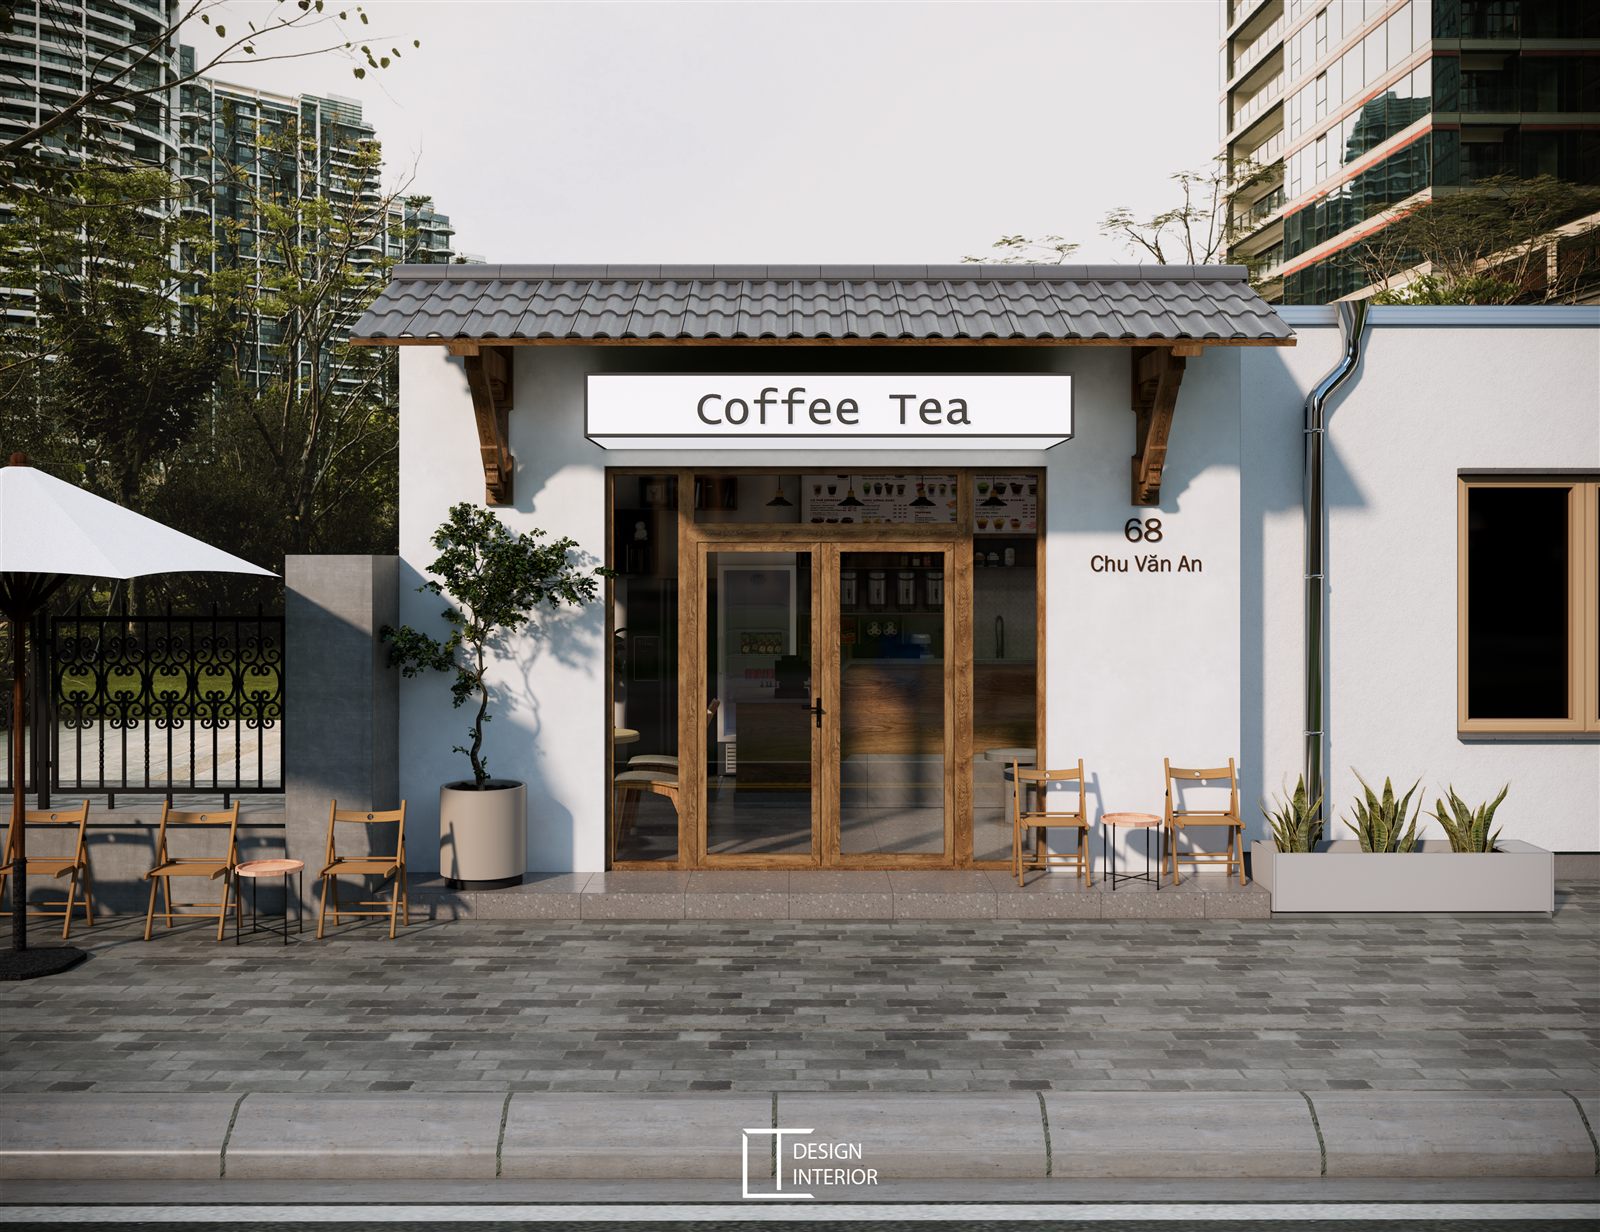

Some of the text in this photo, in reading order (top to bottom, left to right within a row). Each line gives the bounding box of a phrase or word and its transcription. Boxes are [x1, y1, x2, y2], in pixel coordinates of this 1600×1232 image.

[697, 387, 972, 425] Coffee Tea
[1123, 517, 1163, 543] 68
[1090, 553, 1202, 573] Chu Văn An
